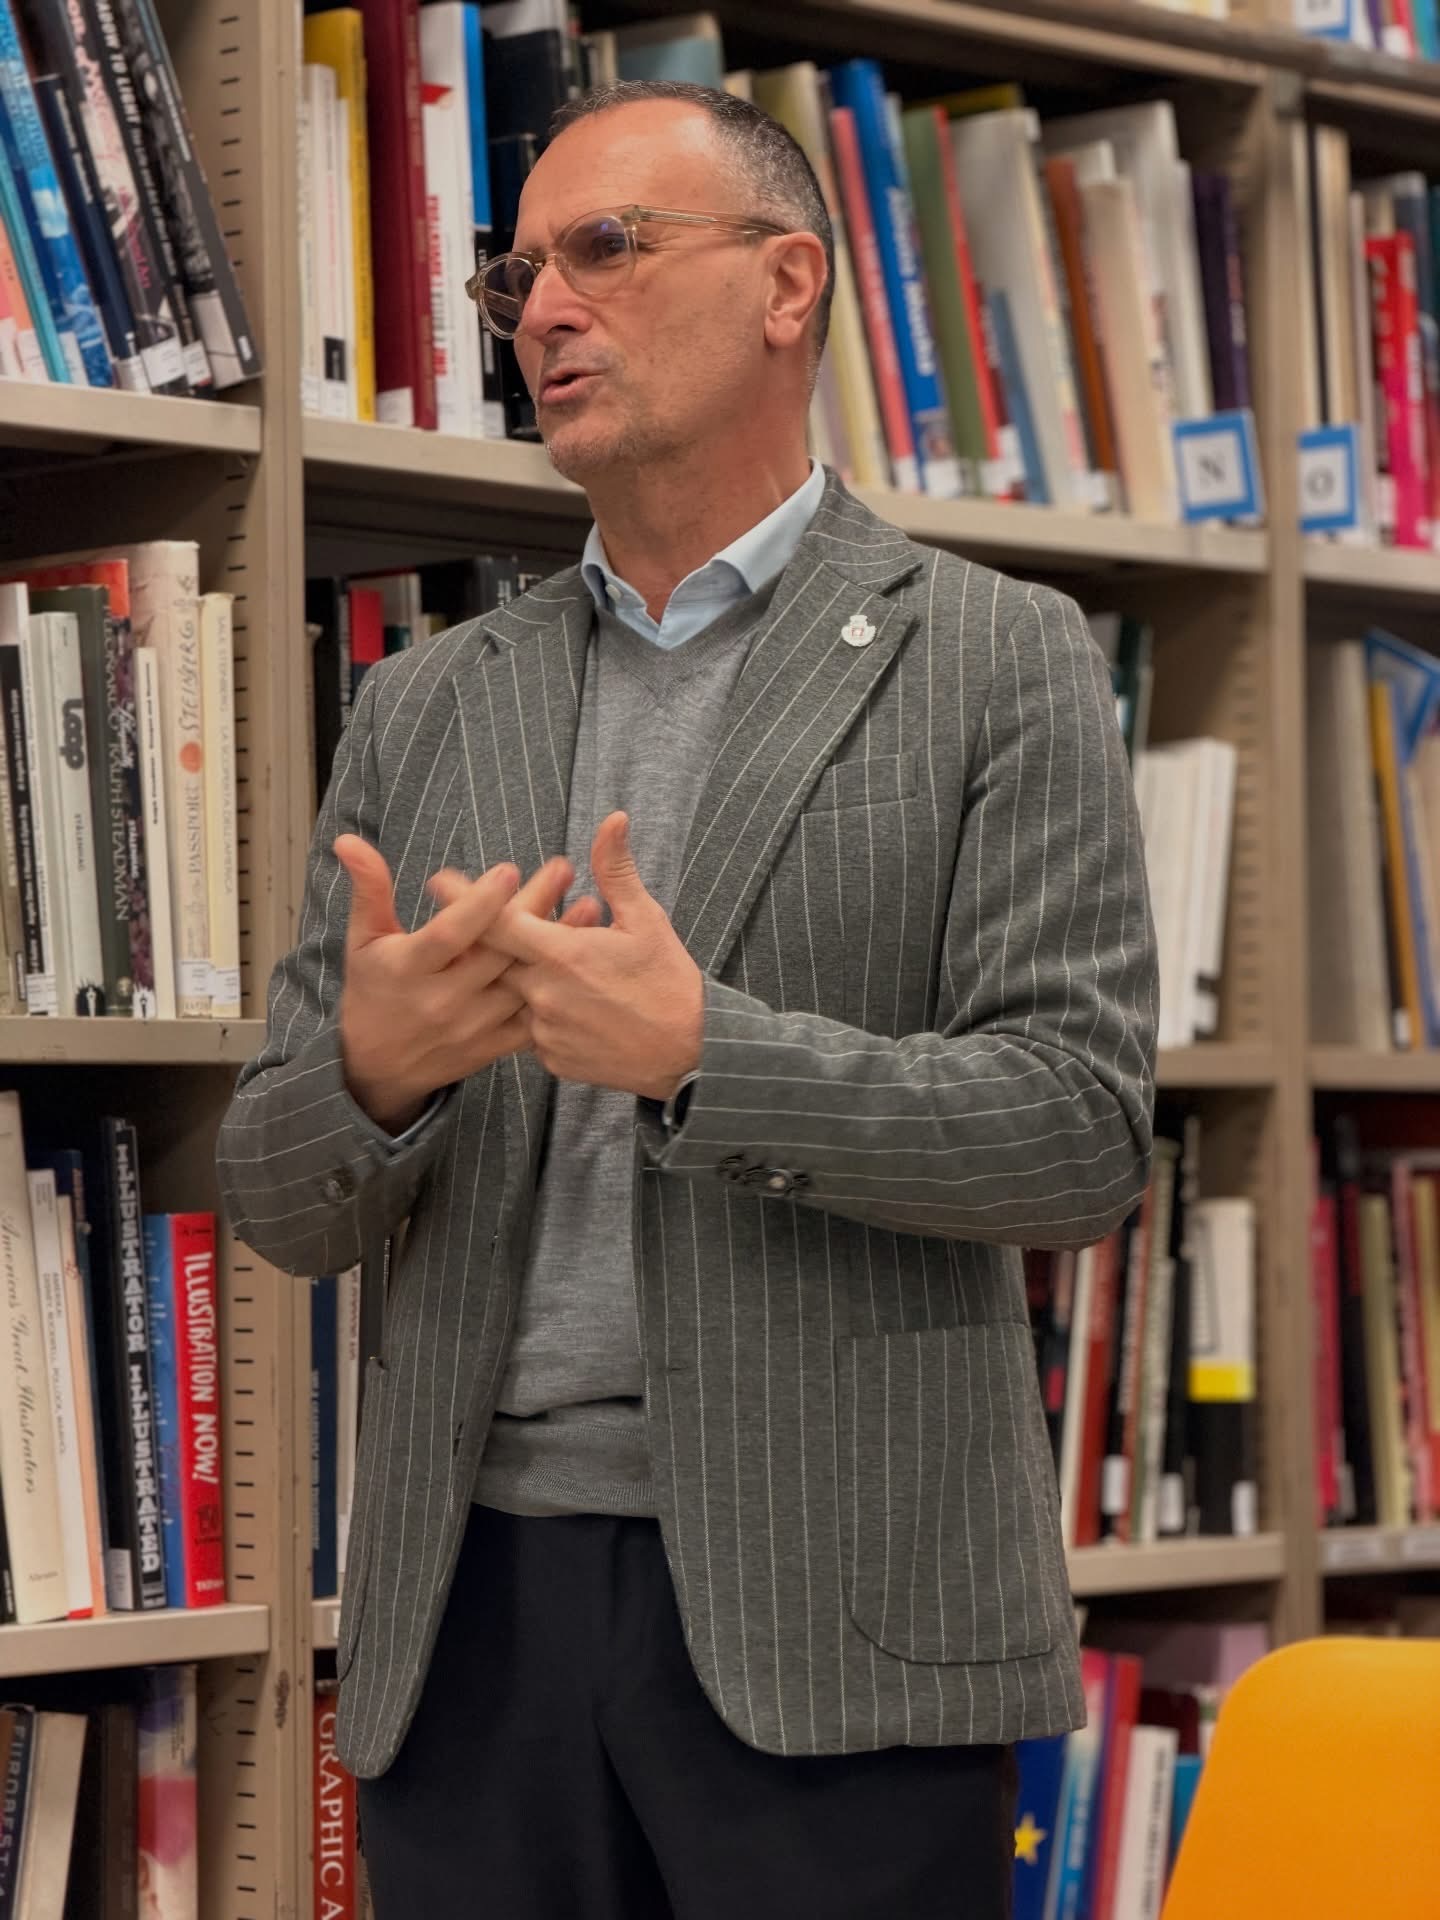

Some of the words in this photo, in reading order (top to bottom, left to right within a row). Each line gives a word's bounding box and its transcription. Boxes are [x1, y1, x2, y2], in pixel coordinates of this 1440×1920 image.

[109, 54, 127, 74] TO
[116, 77, 141, 123] LIGHT
[178, 619, 196, 732] STEINBERG
[108, 742, 124, 805] RALPH
[111, 808, 129, 921] STEADMAN
[185, 785, 202, 875] PASSPORT
[116, 1144, 147, 1354] ILLUSTRATOR
[184, 1251, 217, 1403] ILLUSTRATION
[129, 1364, 162, 1574] ILLUSTRATED
[191, 1412, 219, 1485] NOW!
